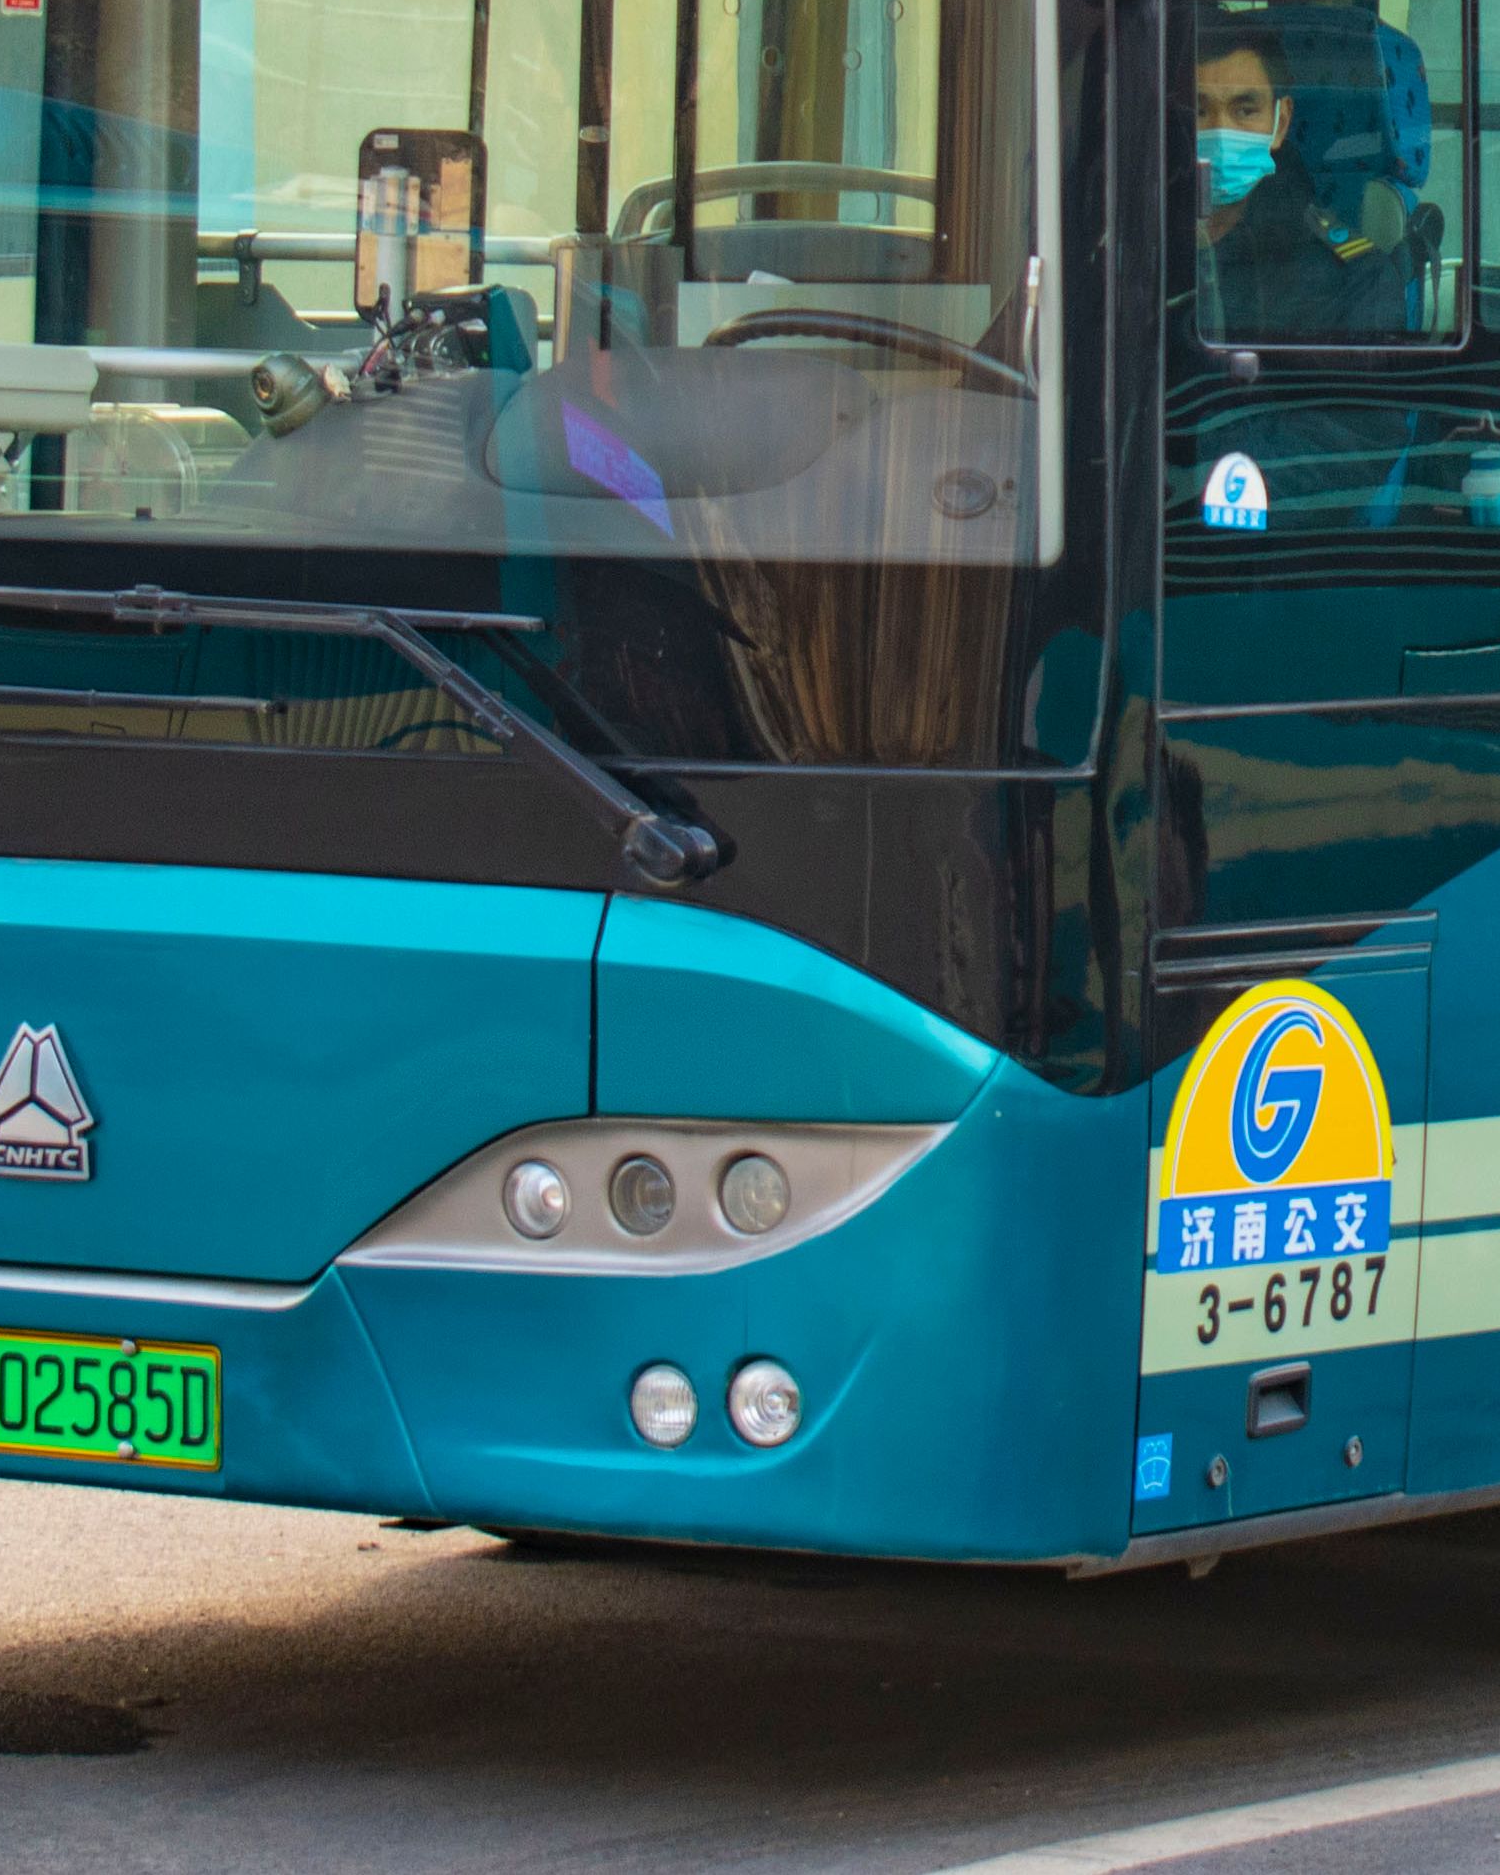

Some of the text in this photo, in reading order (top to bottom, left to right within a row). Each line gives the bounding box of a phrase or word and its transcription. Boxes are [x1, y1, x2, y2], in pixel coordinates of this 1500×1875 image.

[1180, 1192, 1369, 1267] 济南公交
[1196, 1255, 1387, 1346] 3-6787
